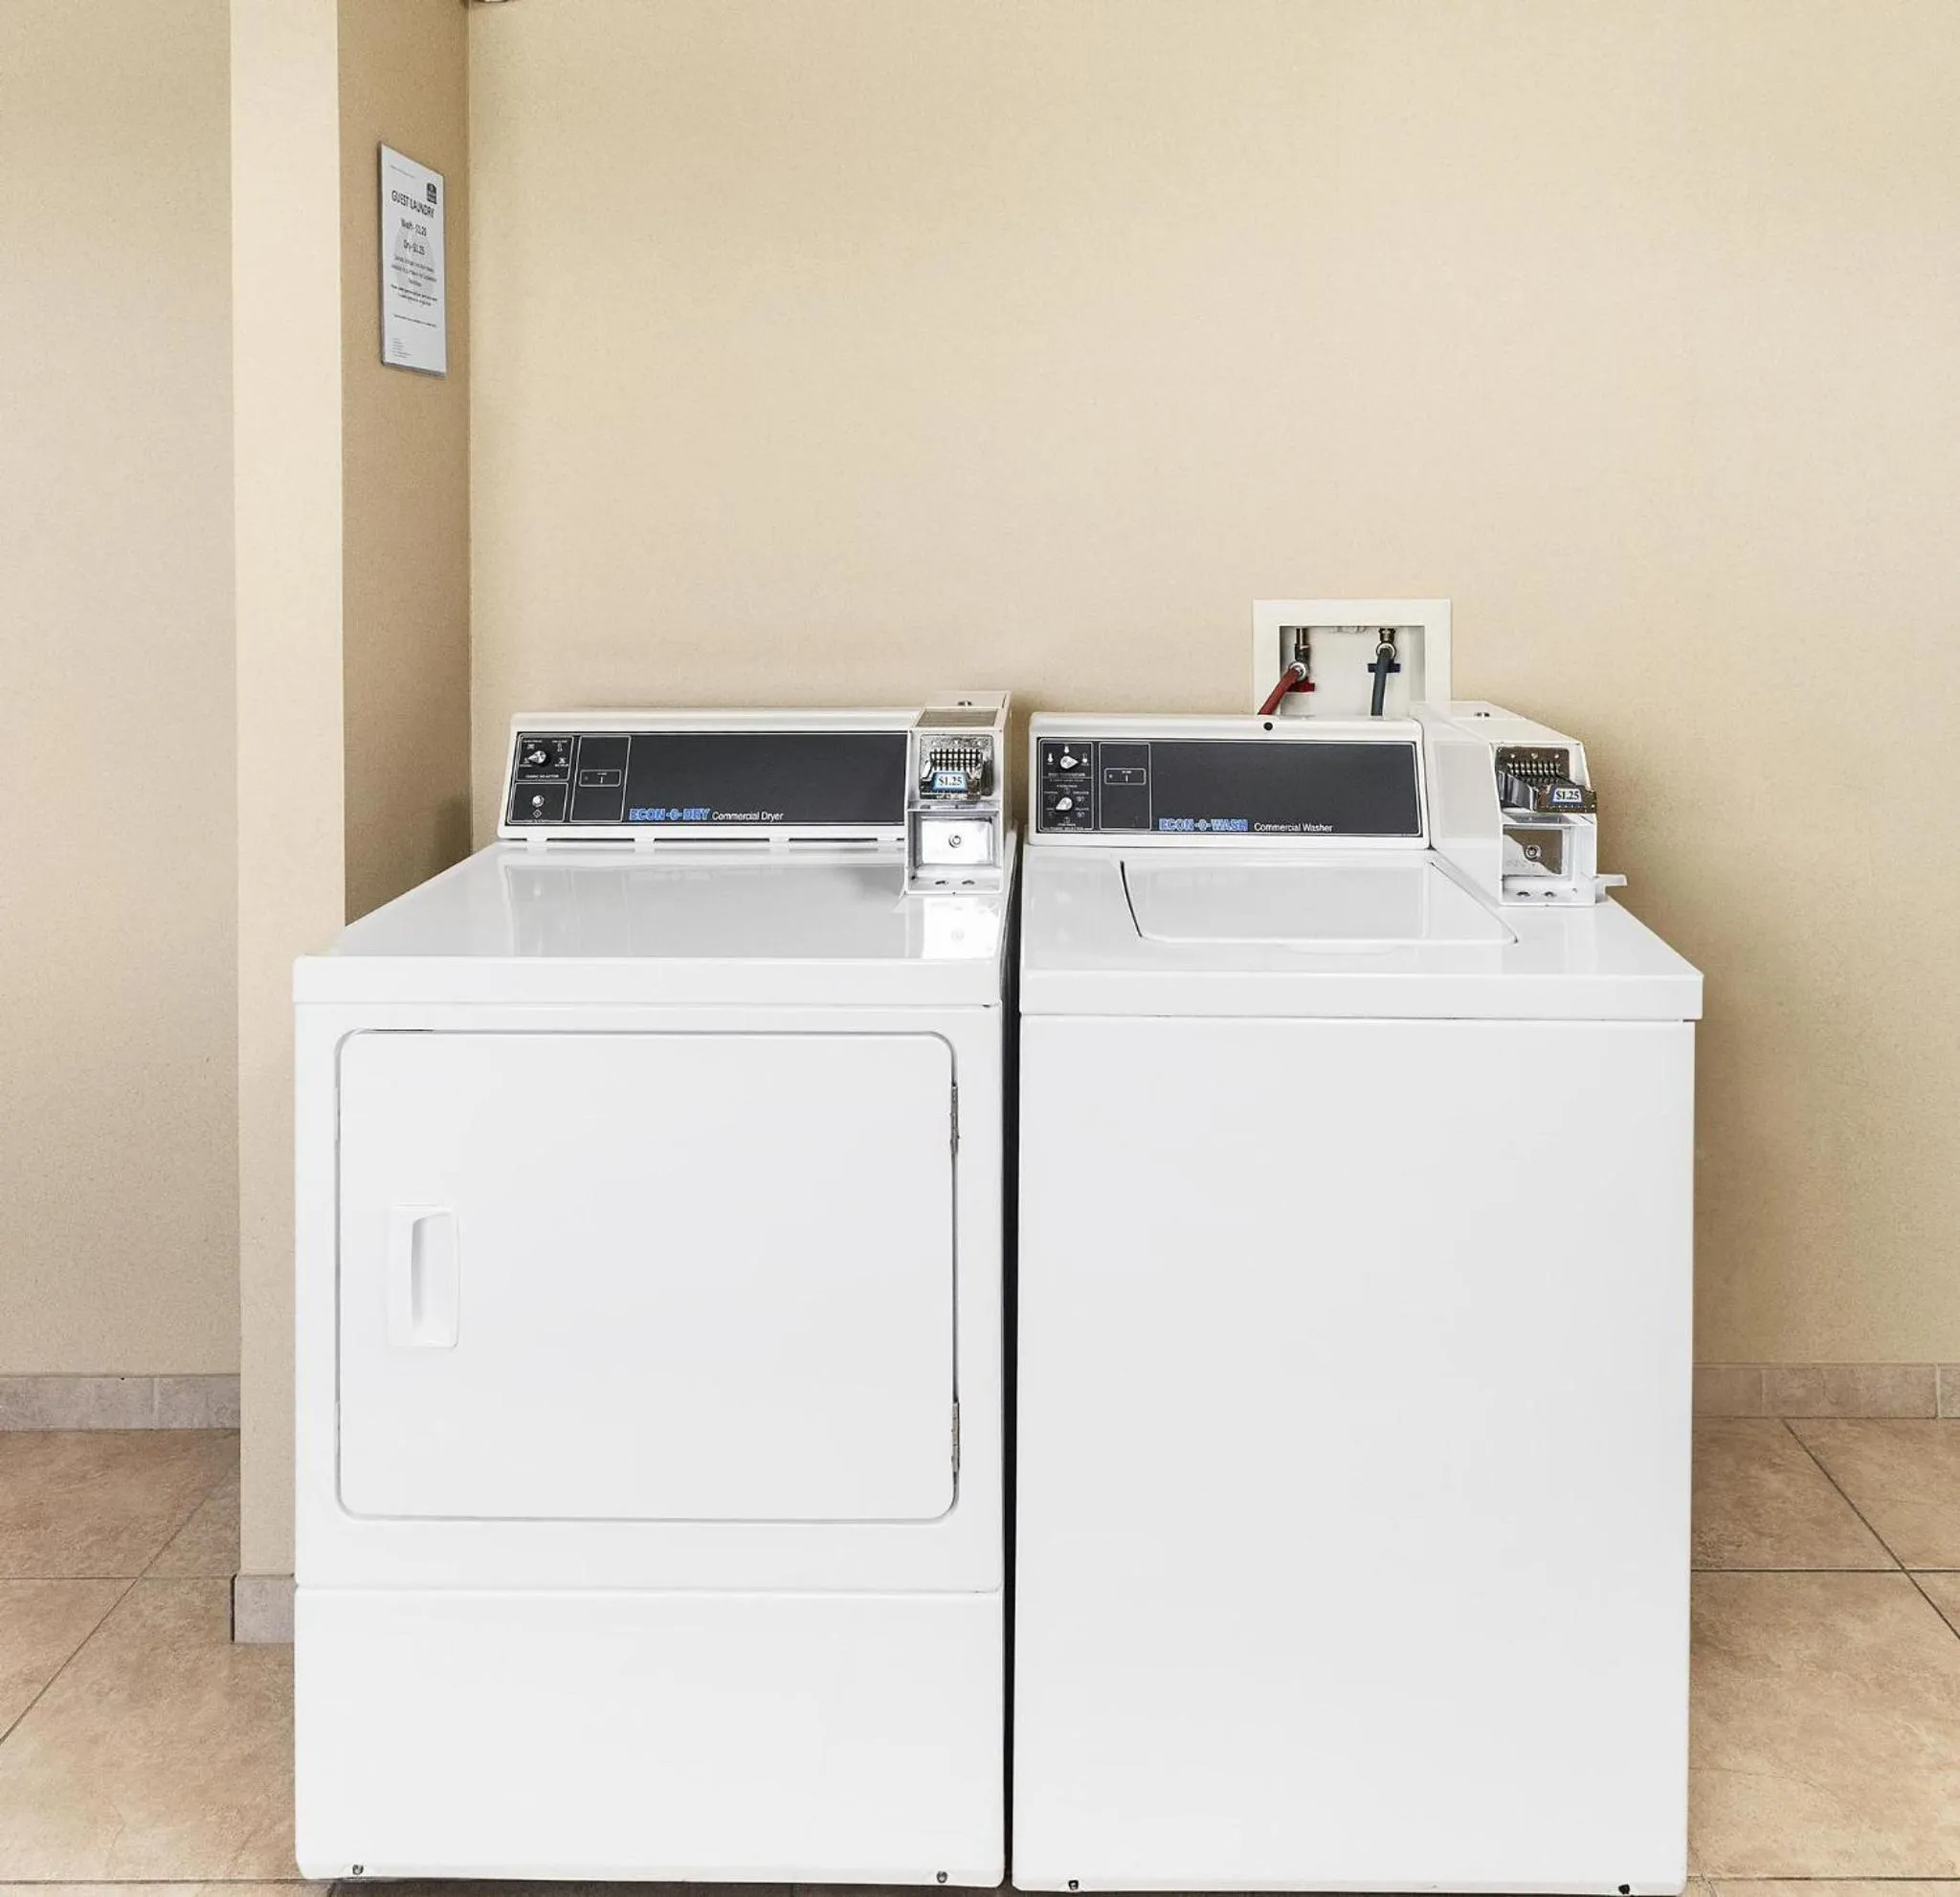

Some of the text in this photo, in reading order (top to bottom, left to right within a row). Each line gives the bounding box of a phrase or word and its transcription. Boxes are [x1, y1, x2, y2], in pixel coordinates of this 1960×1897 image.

[938, 775, 963, 786] $1.25
[1555, 790, 1580, 800] $1.25
[712, 811, 760, 821] Commercial
[761, 811, 784, 822] Dryer
[1254, 822, 1300, 832] Commercial
[1303, 823, 1333, 833] Washer
